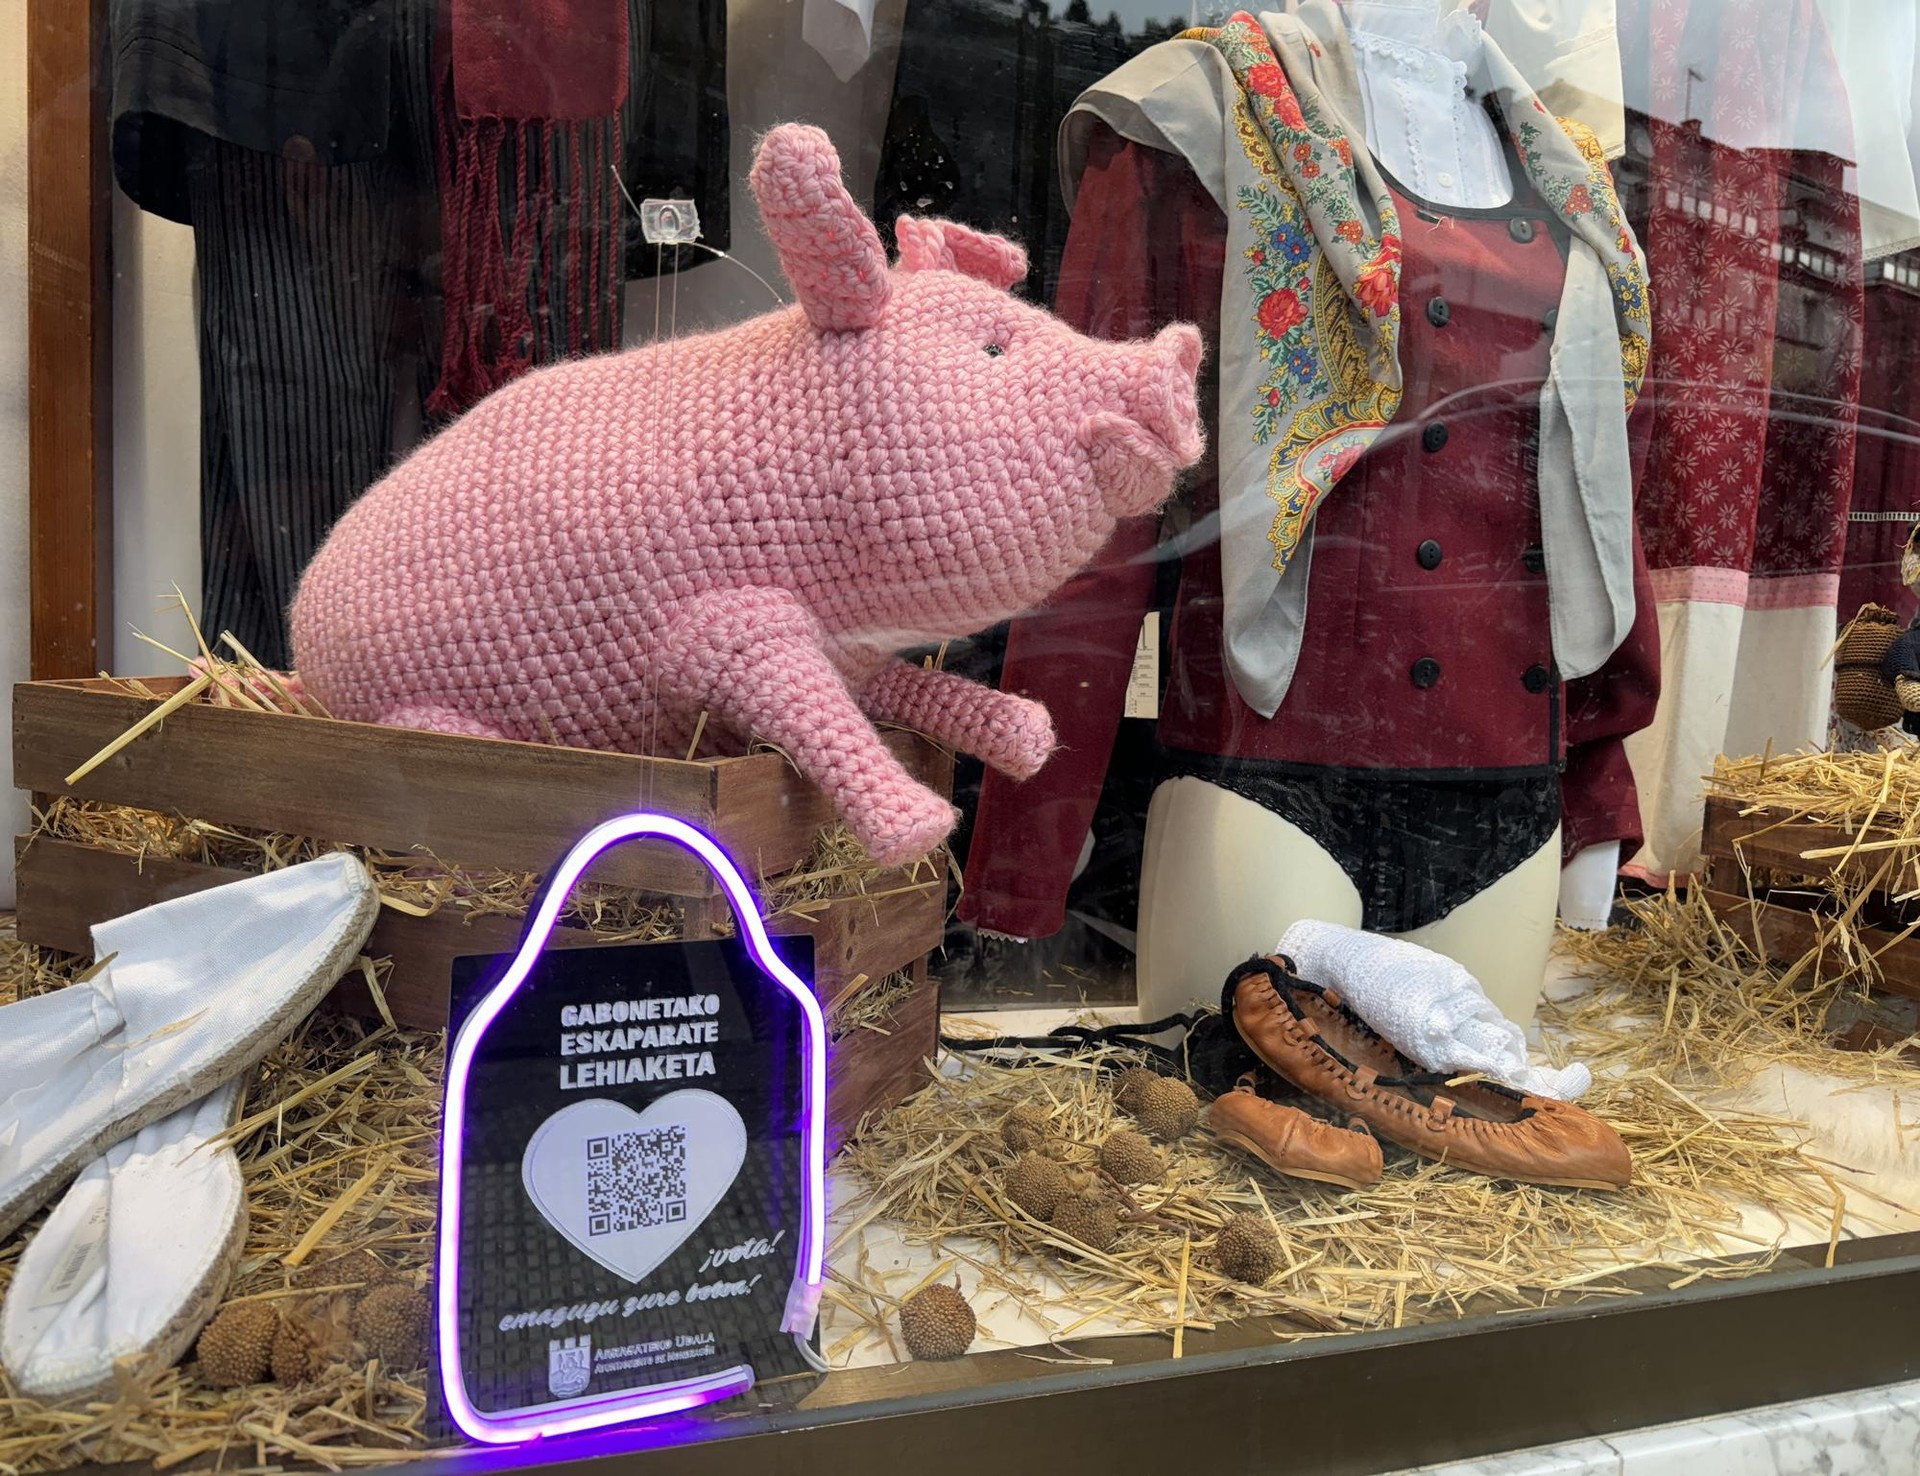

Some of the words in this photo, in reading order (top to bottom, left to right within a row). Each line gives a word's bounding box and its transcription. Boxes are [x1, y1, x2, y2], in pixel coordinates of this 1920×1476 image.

[561, 994, 720, 1027] GABONETAKO
[560, 1021, 719, 1056] ESKAPARATE
[560, 1051, 716, 1090] LEHIAKETA
[622, 1289, 681, 1318] zure
[675, 1332, 715, 1349] UDALA
